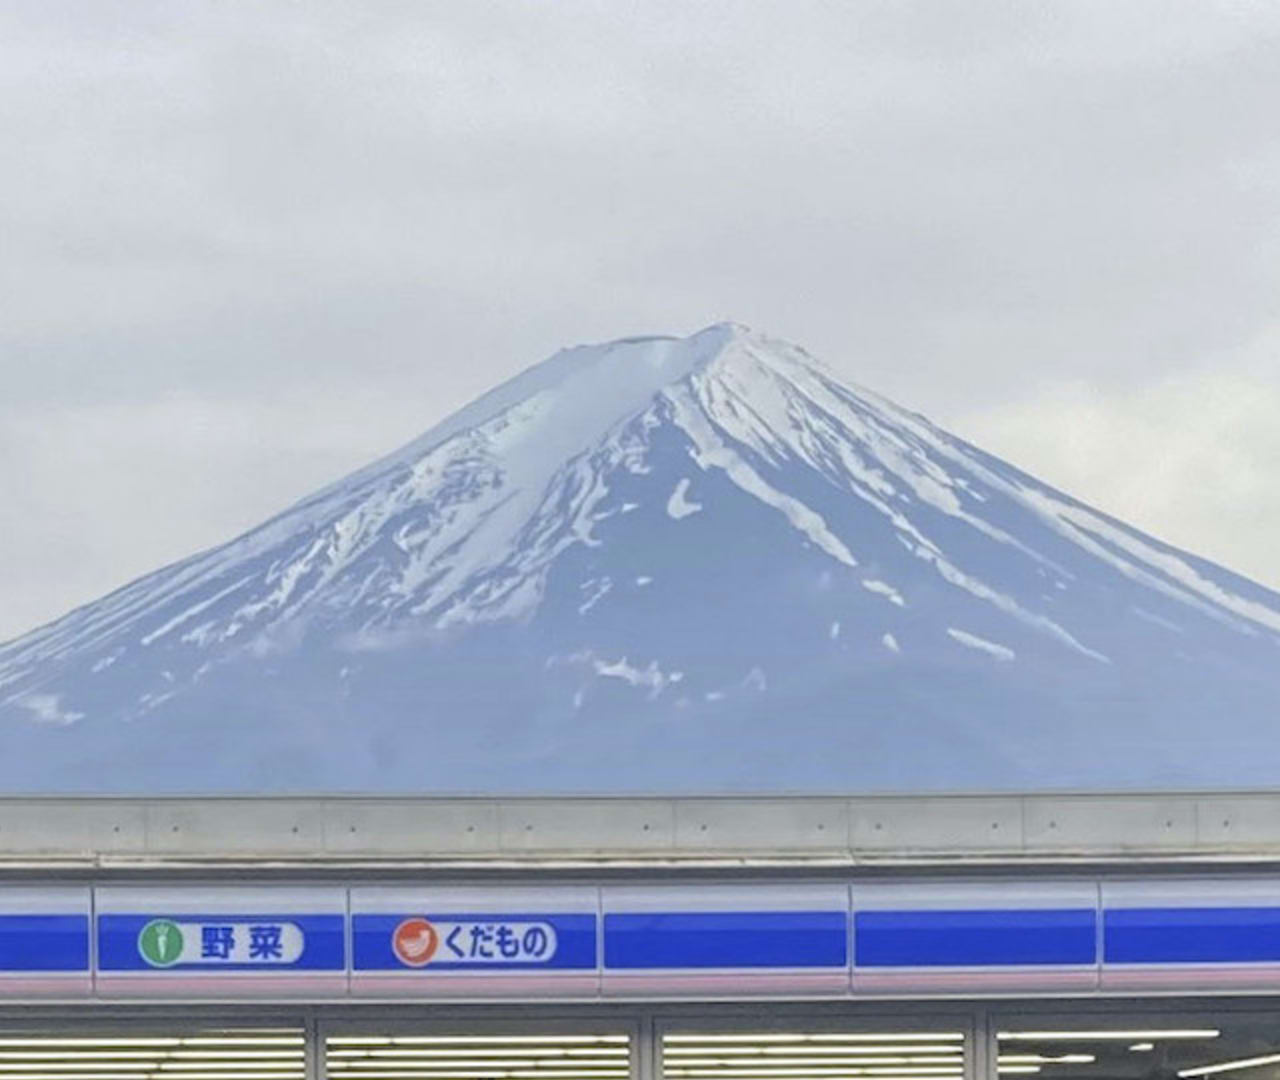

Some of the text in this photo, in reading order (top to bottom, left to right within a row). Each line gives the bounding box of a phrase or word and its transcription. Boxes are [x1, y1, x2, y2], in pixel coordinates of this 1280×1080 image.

[200, 926, 284, 960] 野菜
[444, 925, 549, 959] くだもの
